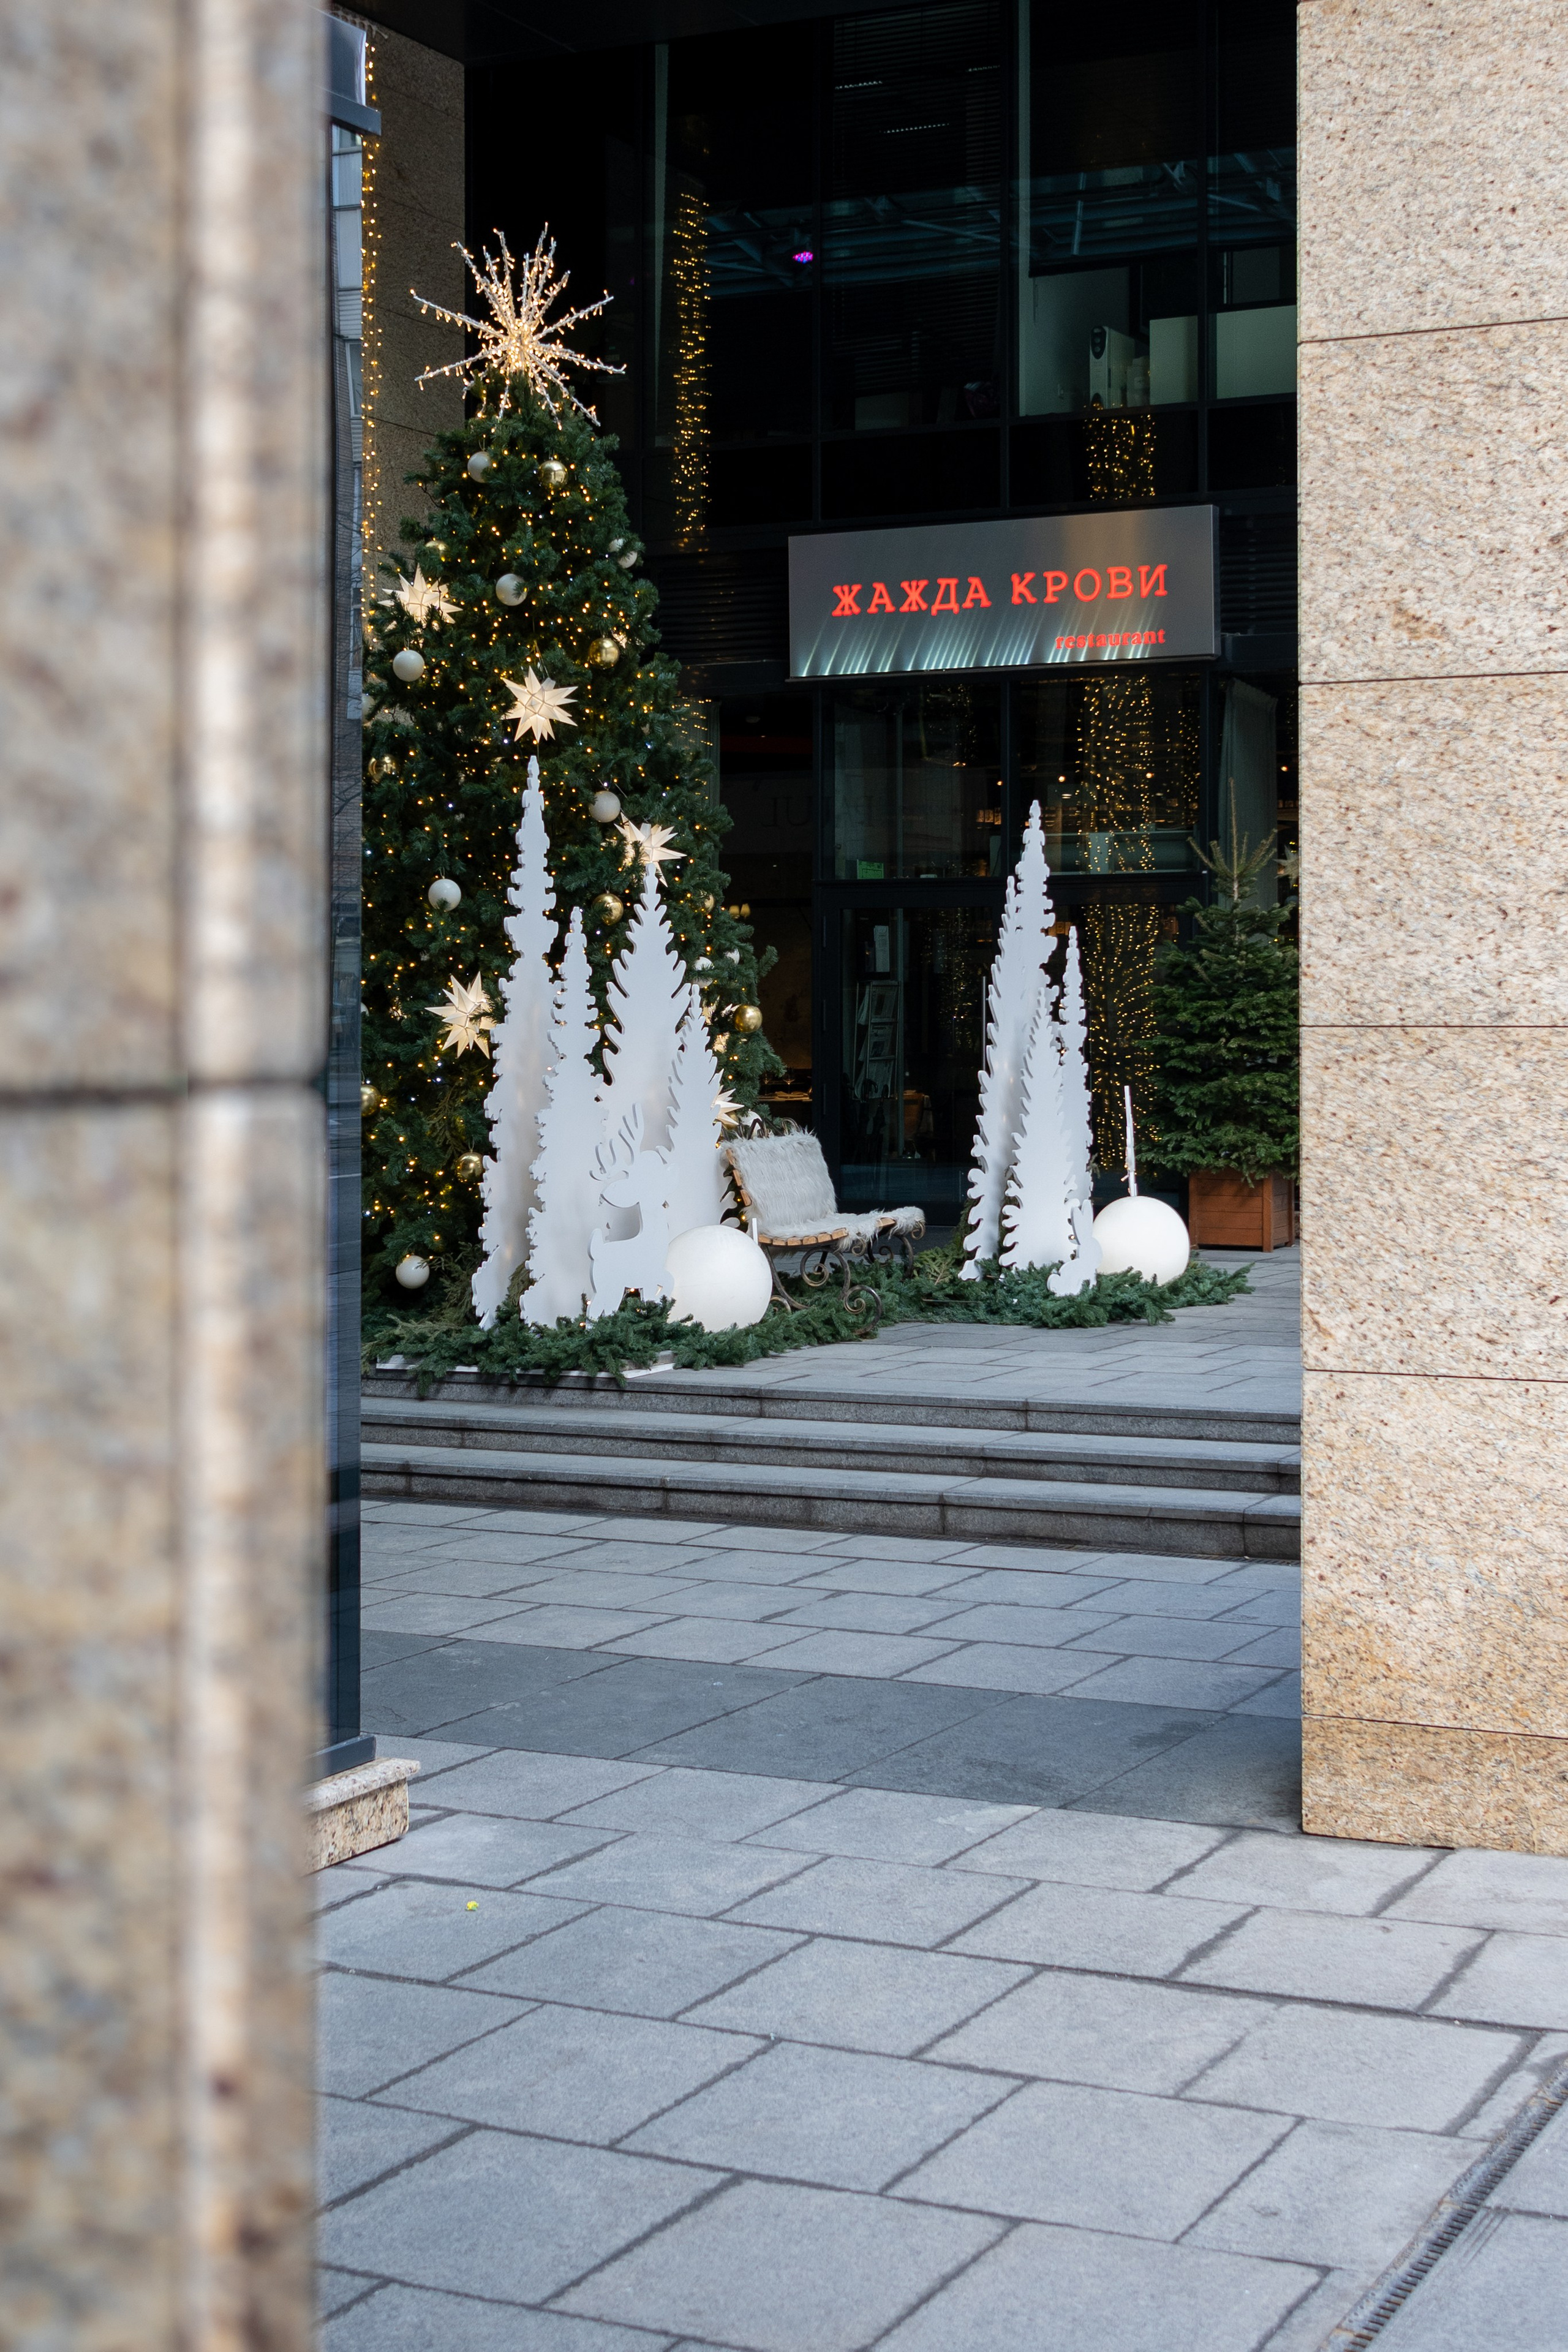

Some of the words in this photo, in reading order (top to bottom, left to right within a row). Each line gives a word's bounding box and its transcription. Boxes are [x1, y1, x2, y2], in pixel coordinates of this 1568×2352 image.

[831, 575, 992, 616] ЖАЖДА
[1011, 564, 1168, 606] КРОВИ
[1055, 628, 1166, 649] restaurant
